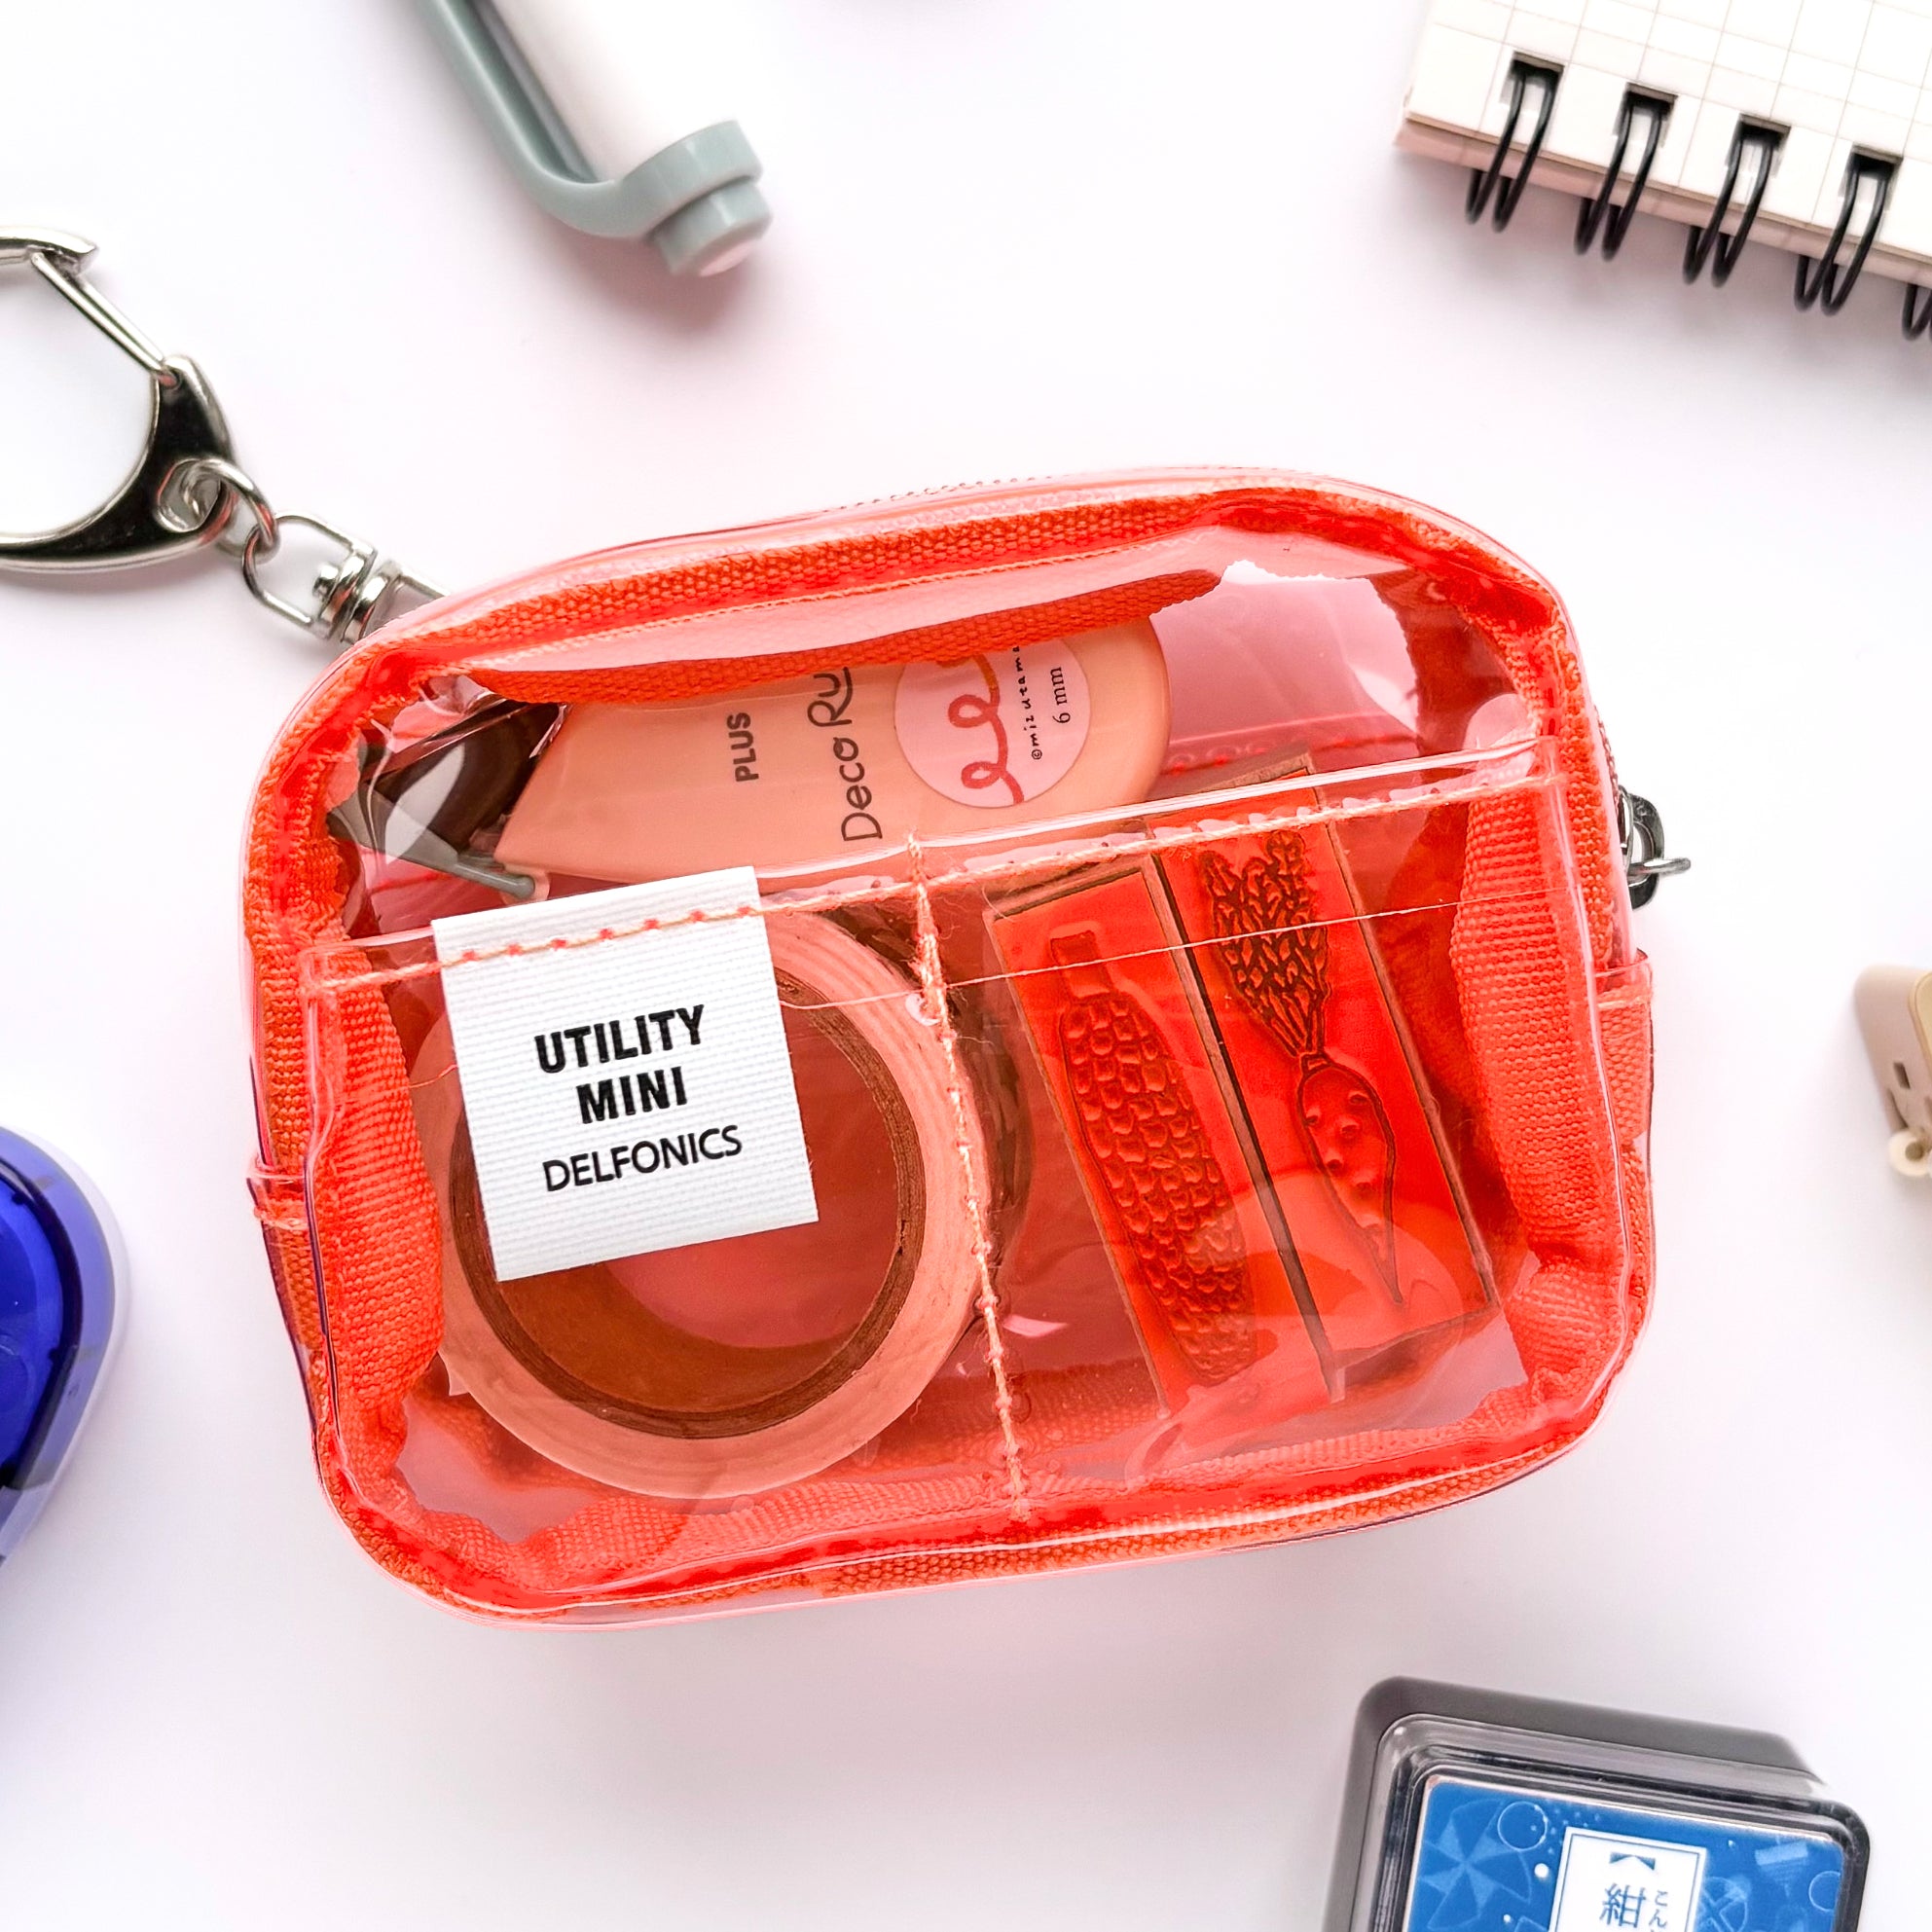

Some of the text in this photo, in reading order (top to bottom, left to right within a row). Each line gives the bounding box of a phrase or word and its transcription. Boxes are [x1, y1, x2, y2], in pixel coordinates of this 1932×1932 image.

[1049, 666, 1072, 724] 6 mm
[726, 711, 759, 783] PLUS
[832, 737, 883, 842] Deco
[534, 1003, 705, 1074] UTILITY
[575, 1066, 688, 1125] MINI
[542, 1124, 744, 1192] DELFONICS
[1599, 1881, 1647, 1929] 紺
[1648, 1889, 1669, 1932] こん
